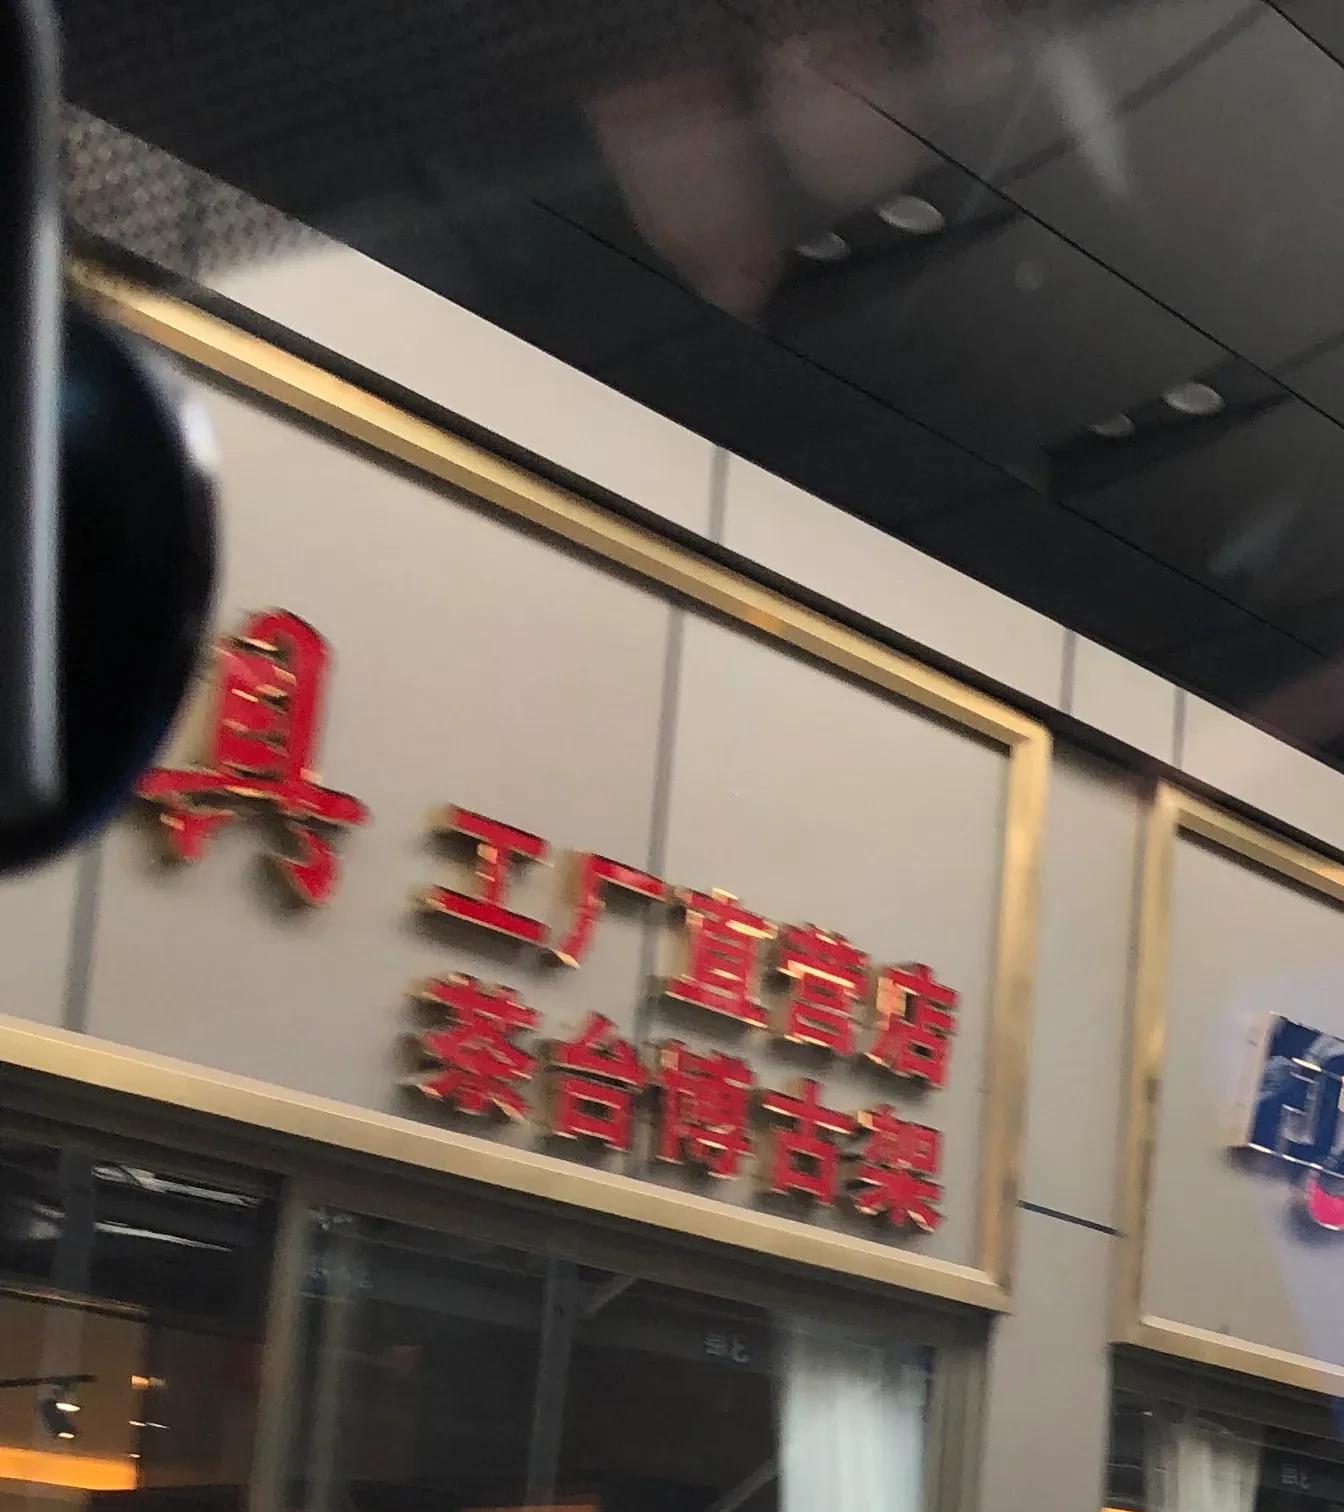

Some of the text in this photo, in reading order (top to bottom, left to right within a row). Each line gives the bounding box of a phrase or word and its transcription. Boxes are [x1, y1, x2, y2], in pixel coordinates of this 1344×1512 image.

[420, 803, 960, 1090] 工厂直营店
[412, 972, 945, 1236] 茶台博古架
